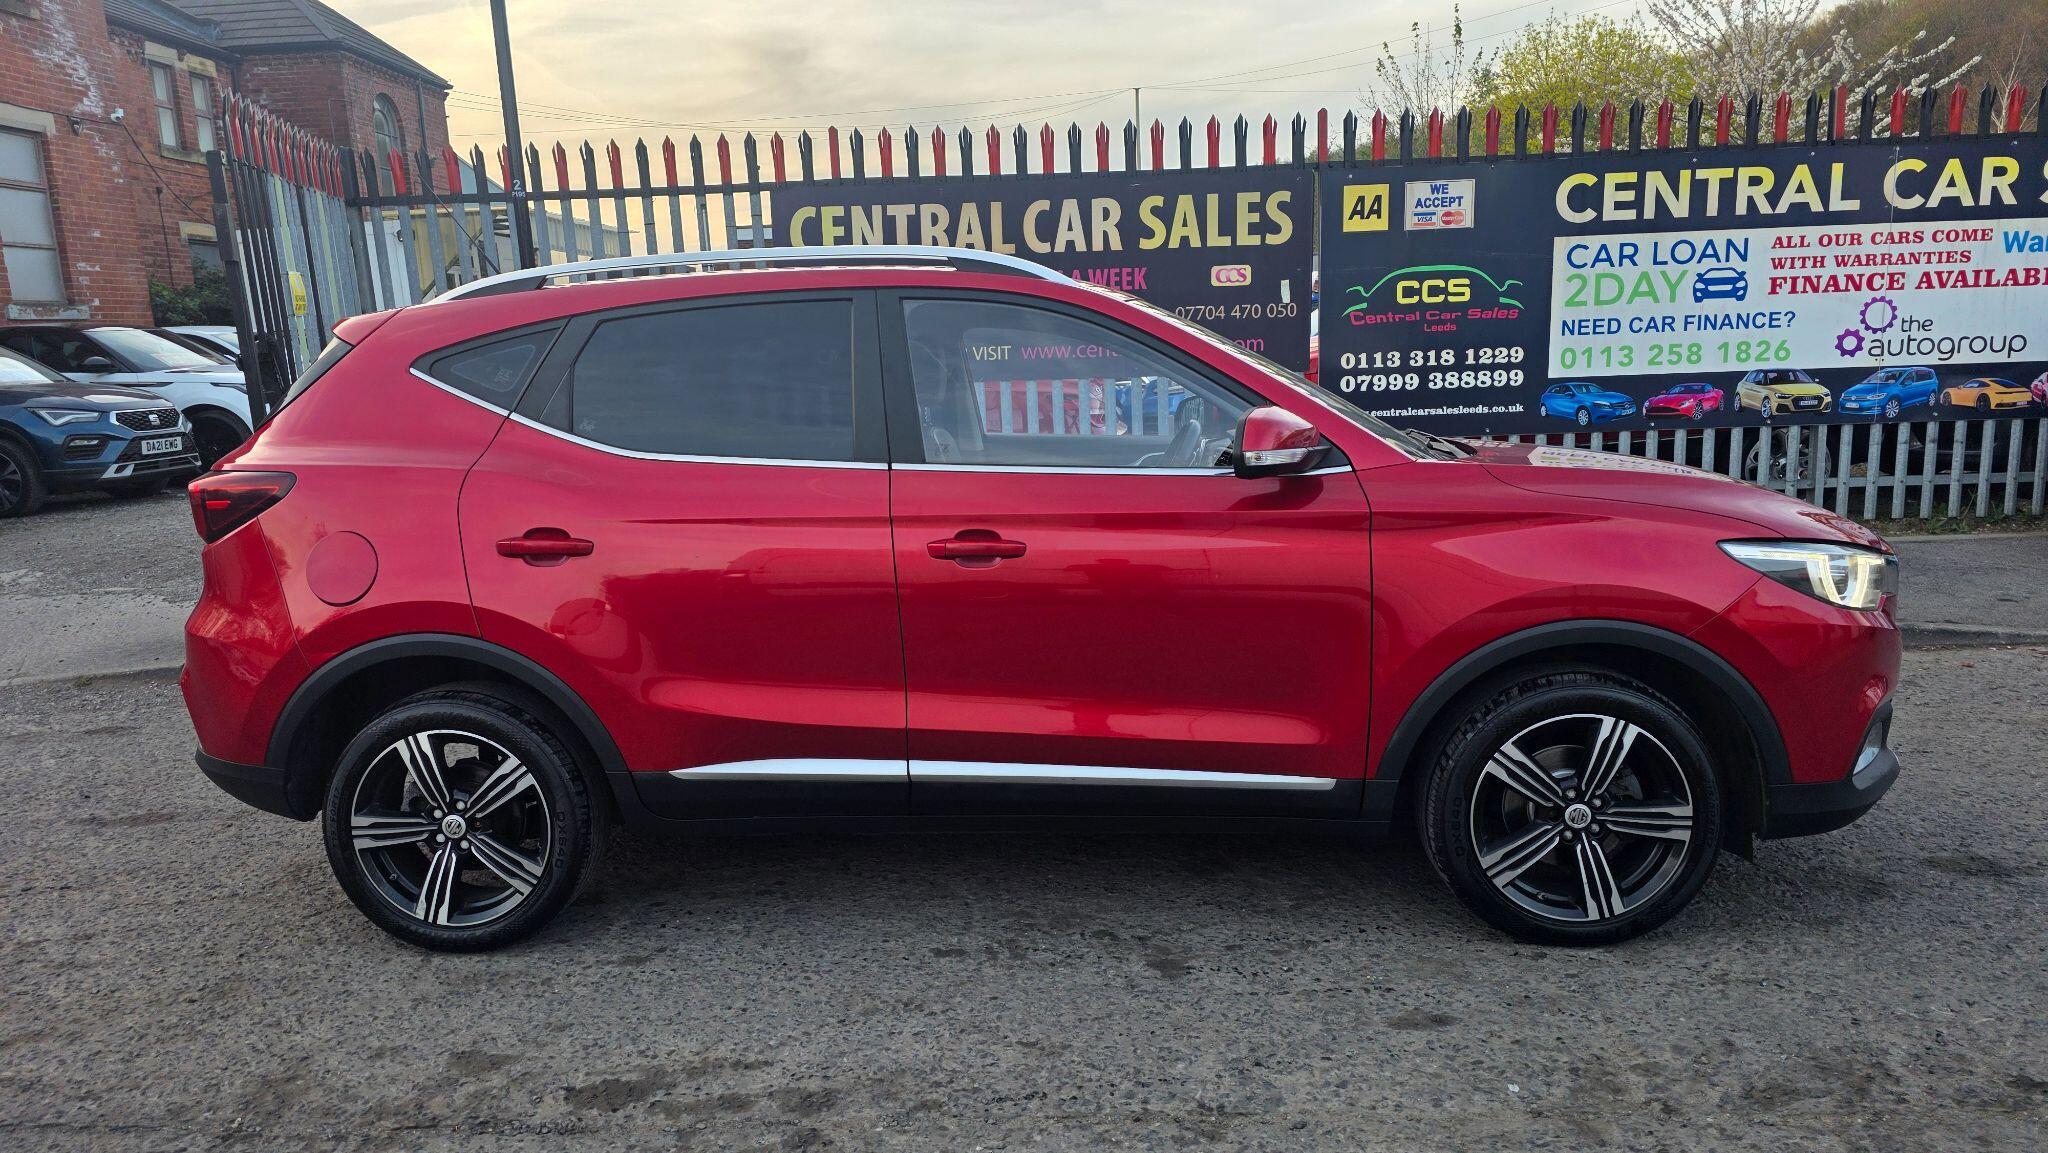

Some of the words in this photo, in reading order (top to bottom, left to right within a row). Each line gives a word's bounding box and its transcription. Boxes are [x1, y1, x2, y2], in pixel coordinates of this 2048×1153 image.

[1430, 184, 1449, 195] WE
[1555, 162, 1861, 224] CENTRAL
[1883, 156, 2020, 209] CAR
[1348, 195, 1383, 220] AA
[1415, 196, 1464, 208] ACCEPT
[789, 201, 1016, 255] CENTRAL
[1023, 197, 1123, 254] CAR
[1138, 190, 1294, 250] SALES
[1771, 235, 1811, 249] ALL
[1818, 233, 1864, 247] OUR
[1870, 230, 1925, 246] CARS
[1931, 228, 1994, 243] COME
[2003, 231, 2048, 253] Wa
[1566, 242, 1639, 269] CAR
[1652, 237, 1749, 265] LOAN
[1771, 255, 1826, 270] WITH
[1833, 250, 1972, 268] WARRANTIES
[1088, 267, 1147, 290] WEEK
[1215, 267, 1248, 284] CCS
[1768, 271, 1906, 295] FINANCE
[1396, 278, 1471, 304] CCS
[1564, 269, 1689, 308] 2DAY
[1175, 305, 1225, 320] 07704
[1230, 304, 1261, 319] 470
[1266, 302, 1297, 318] 050
[1350, 311, 1420, 326] Central
[1425, 310, 1462, 320] Car
[1467, 307, 1520, 319] Sales
[1424, 323, 1457, 332] Leeds
[1561, 318, 1622, 336] NEED
[1628, 315, 1676, 333] CAR
[1683, 311, 1796, 332] FINANCE?
[1901, 315, 1933, 332] the
[972, 345, 1011, 361] VISIT
[1340, 351, 1401, 370] 0113
[1409, 349, 1456, 367] 318
[1465, 346, 1525, 365] 1229
[1560, 346, 1634, 370] 0113
[1647, 342, 1702, 366] 258
[1716, 339, 1792, 364] 1826
[1868, 334, 2028, 361] autogroup
[1339, 373, 1420, 393] 07999
[1428, 369, 1525, 390] 388899
[1365, 403, 1525, 417] .centralcarsalesleeds.co.uk
[146, 440, 163, 451] DA21
